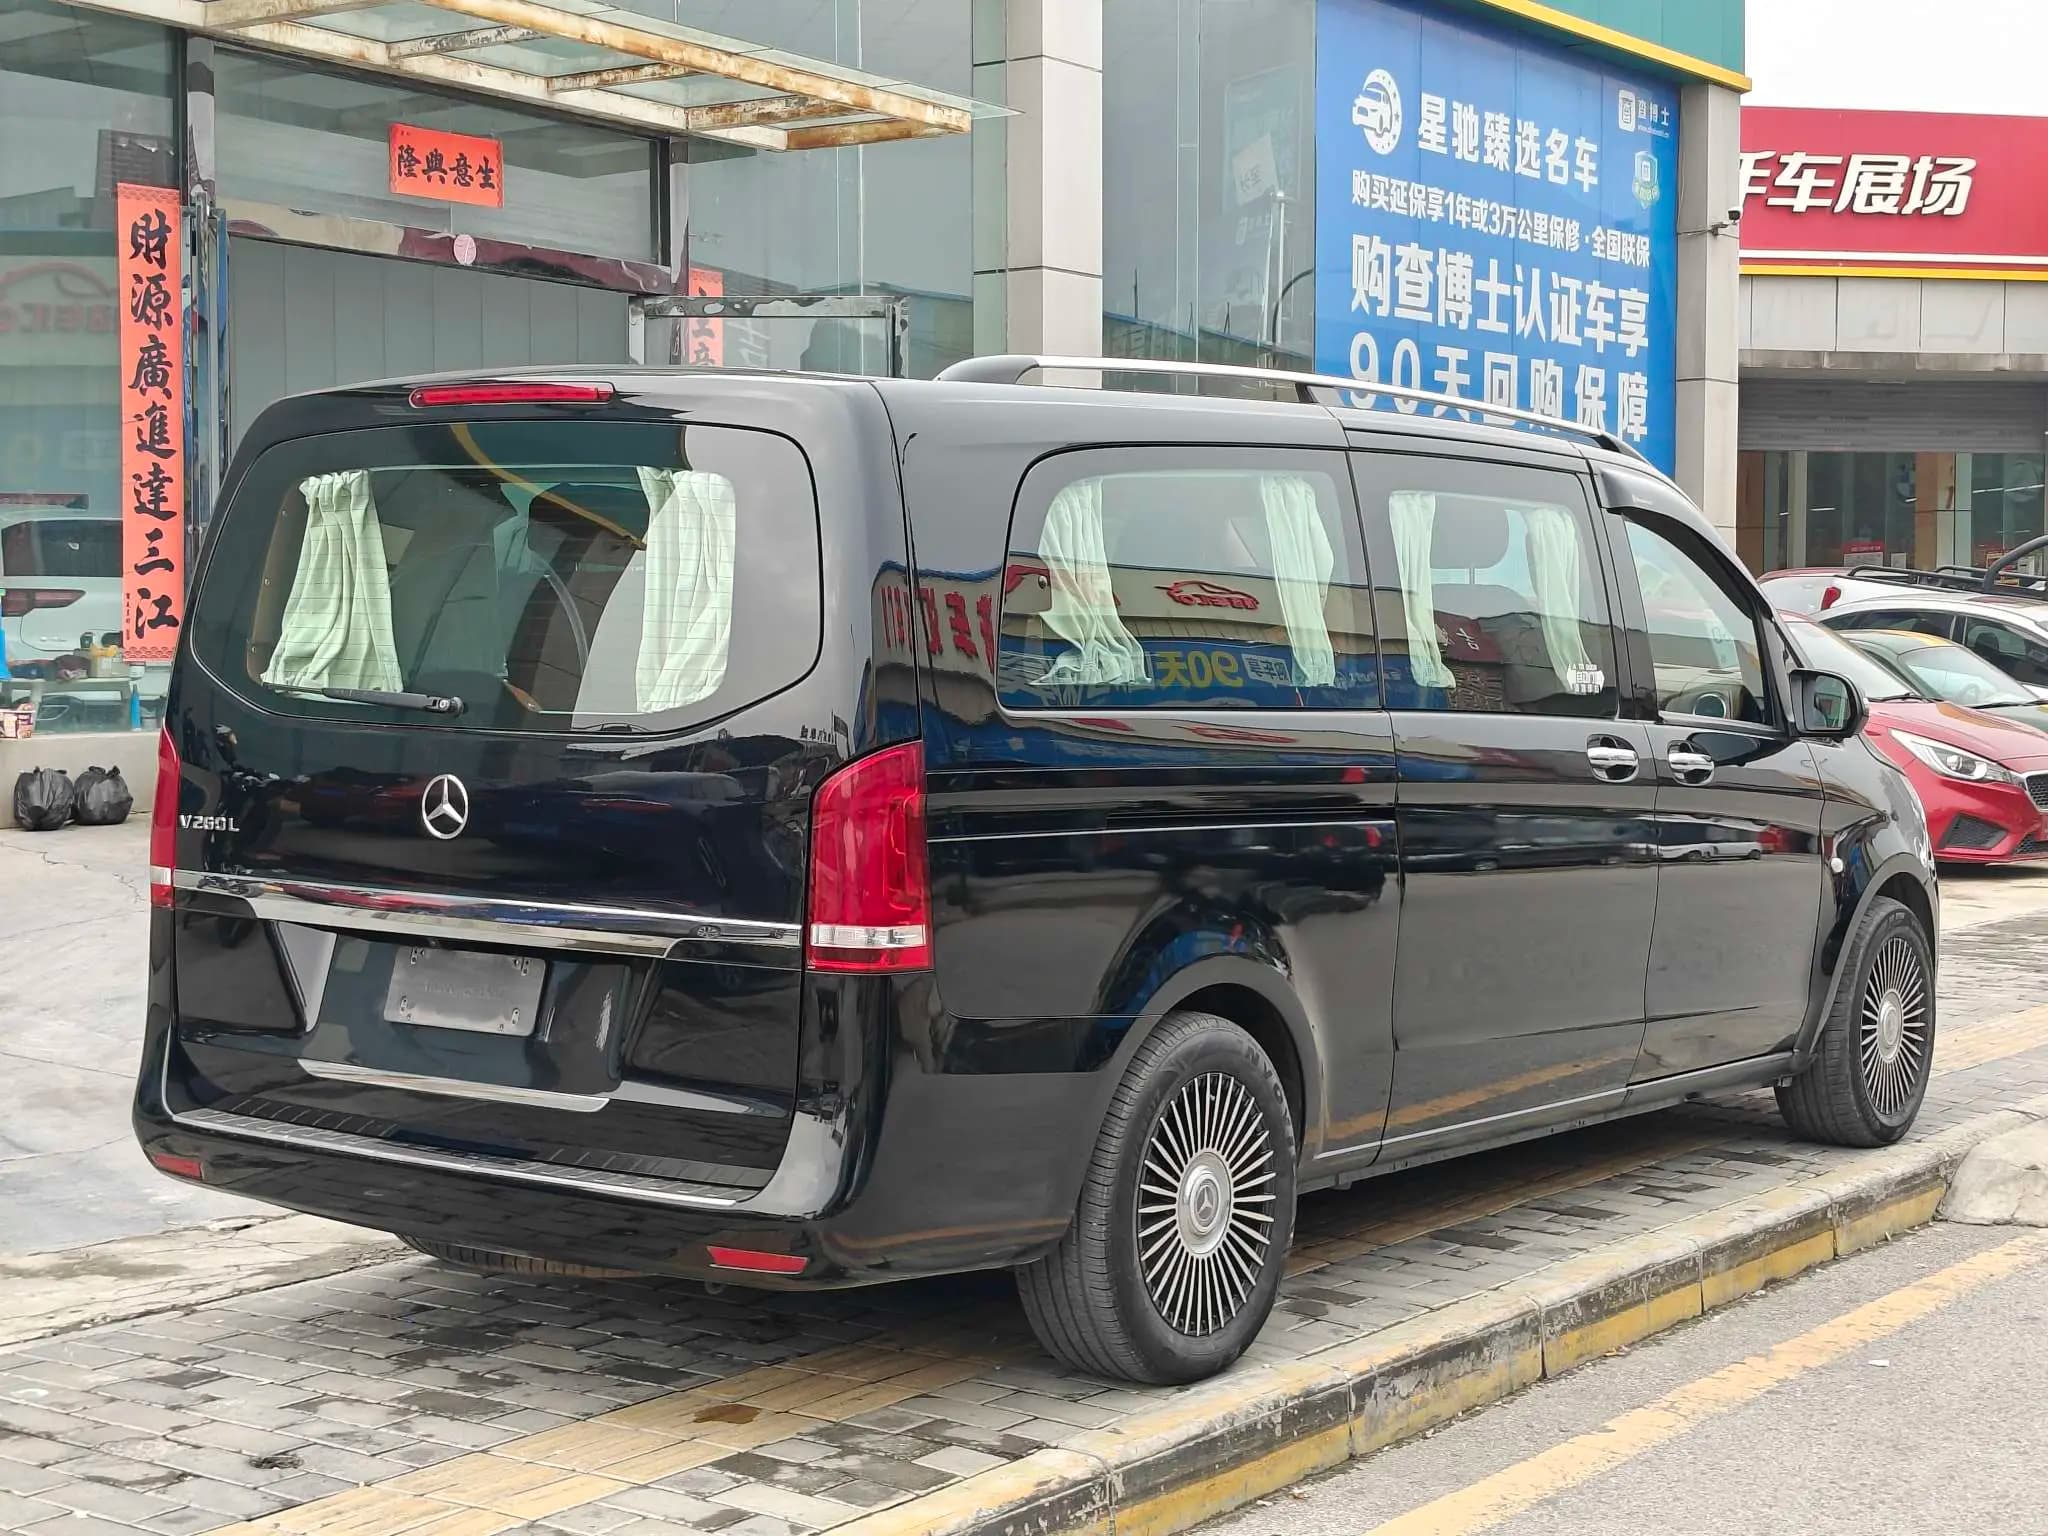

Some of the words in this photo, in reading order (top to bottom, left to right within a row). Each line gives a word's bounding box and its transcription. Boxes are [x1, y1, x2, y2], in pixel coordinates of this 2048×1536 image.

[1418, 93, 1599, 192] 星驰臻选名车
[1350, 234, 1650, 359] 购查博士认证车享
[1349, 332, 1649, 442] 90天回购保障
